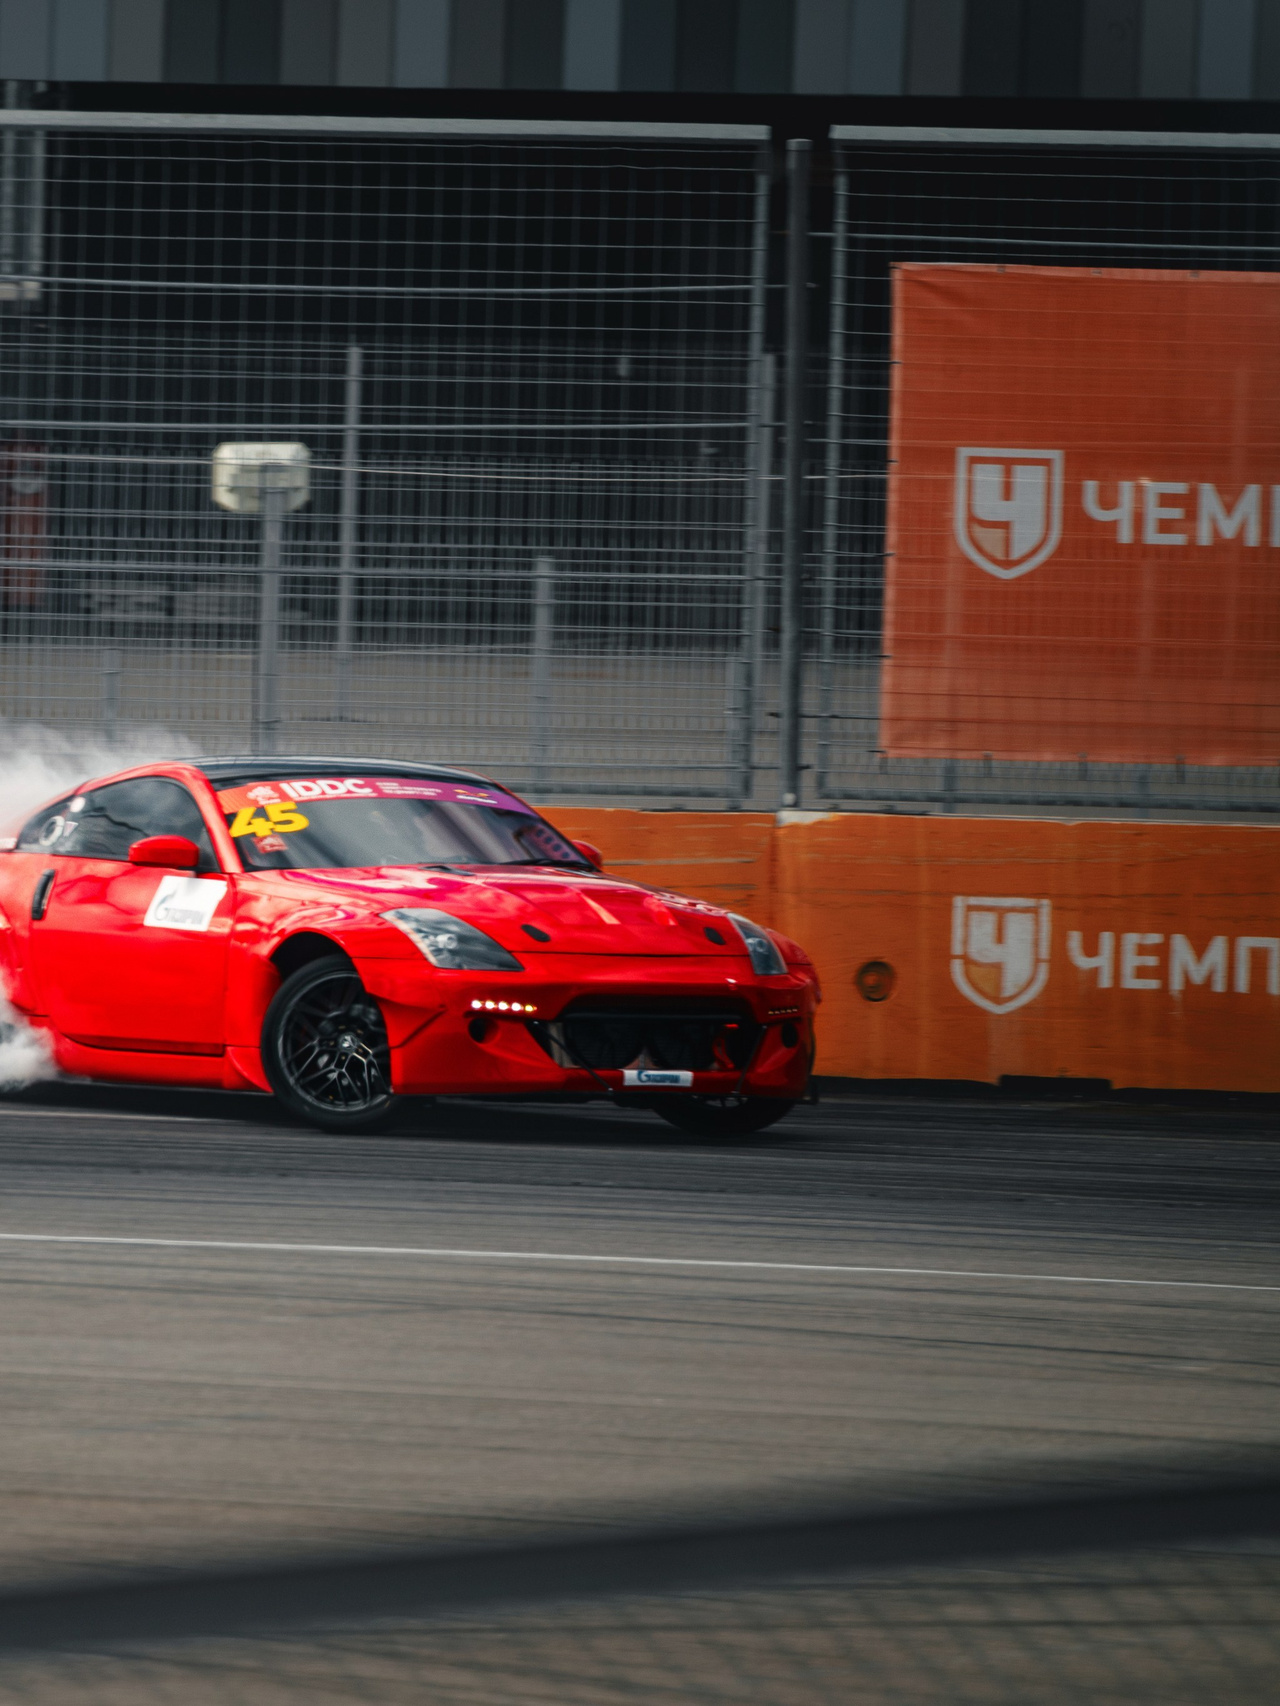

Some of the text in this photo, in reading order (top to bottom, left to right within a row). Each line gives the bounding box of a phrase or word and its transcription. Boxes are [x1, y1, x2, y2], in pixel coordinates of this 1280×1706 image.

[280, 779, 373, 799] IDDC
[230, 802, 309, 838] 45
[1067, 931, 1280, 995] ЧЕМП
